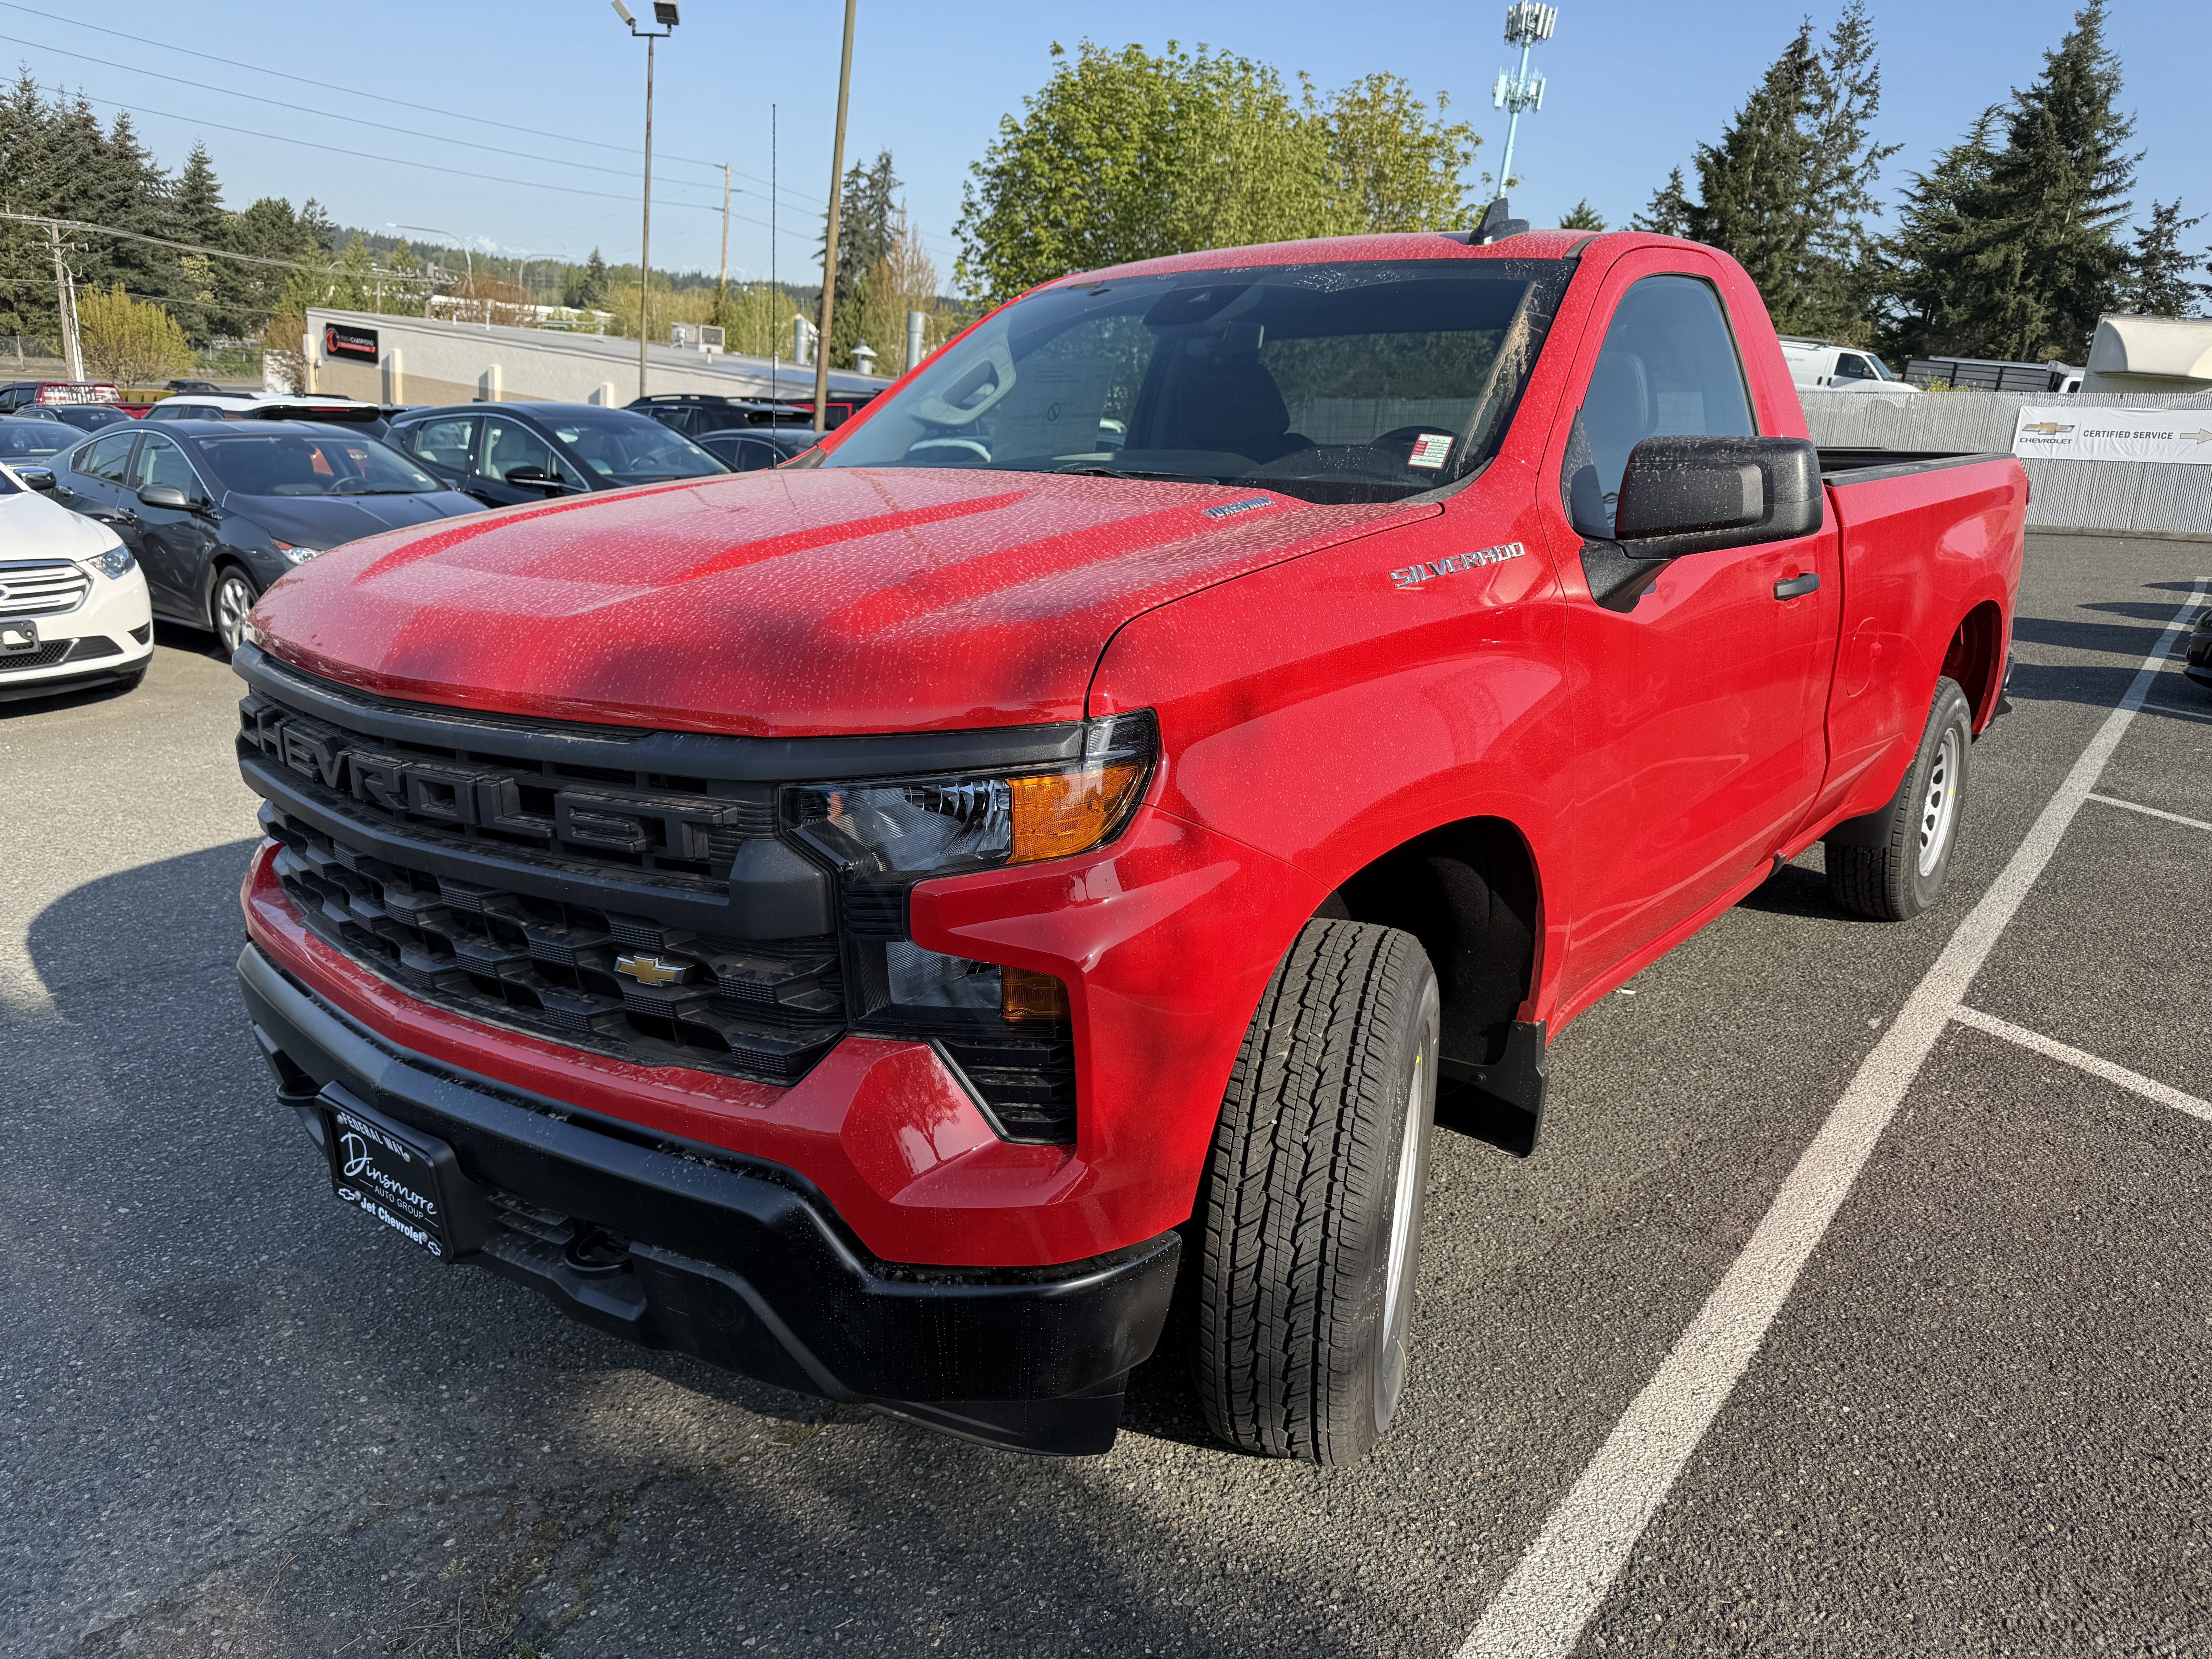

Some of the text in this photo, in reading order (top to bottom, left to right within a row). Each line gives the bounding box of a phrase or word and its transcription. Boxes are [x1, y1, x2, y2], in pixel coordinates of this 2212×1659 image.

[2083, 430, 2173, 440] CERTIFIED SERVICE
[1388, 542, 1525, 588] SILVERADO
[239, 695, 738, 861] CHEVROLET
[341, 1111, 406, 1157] FEDERAL WAY
[340, 1132, 437, 1214] Dinsmore
[361, 1197, 423, 1245] Jet Chevrolet
[374, 1185, 424, 1219] AUTO GROUP
